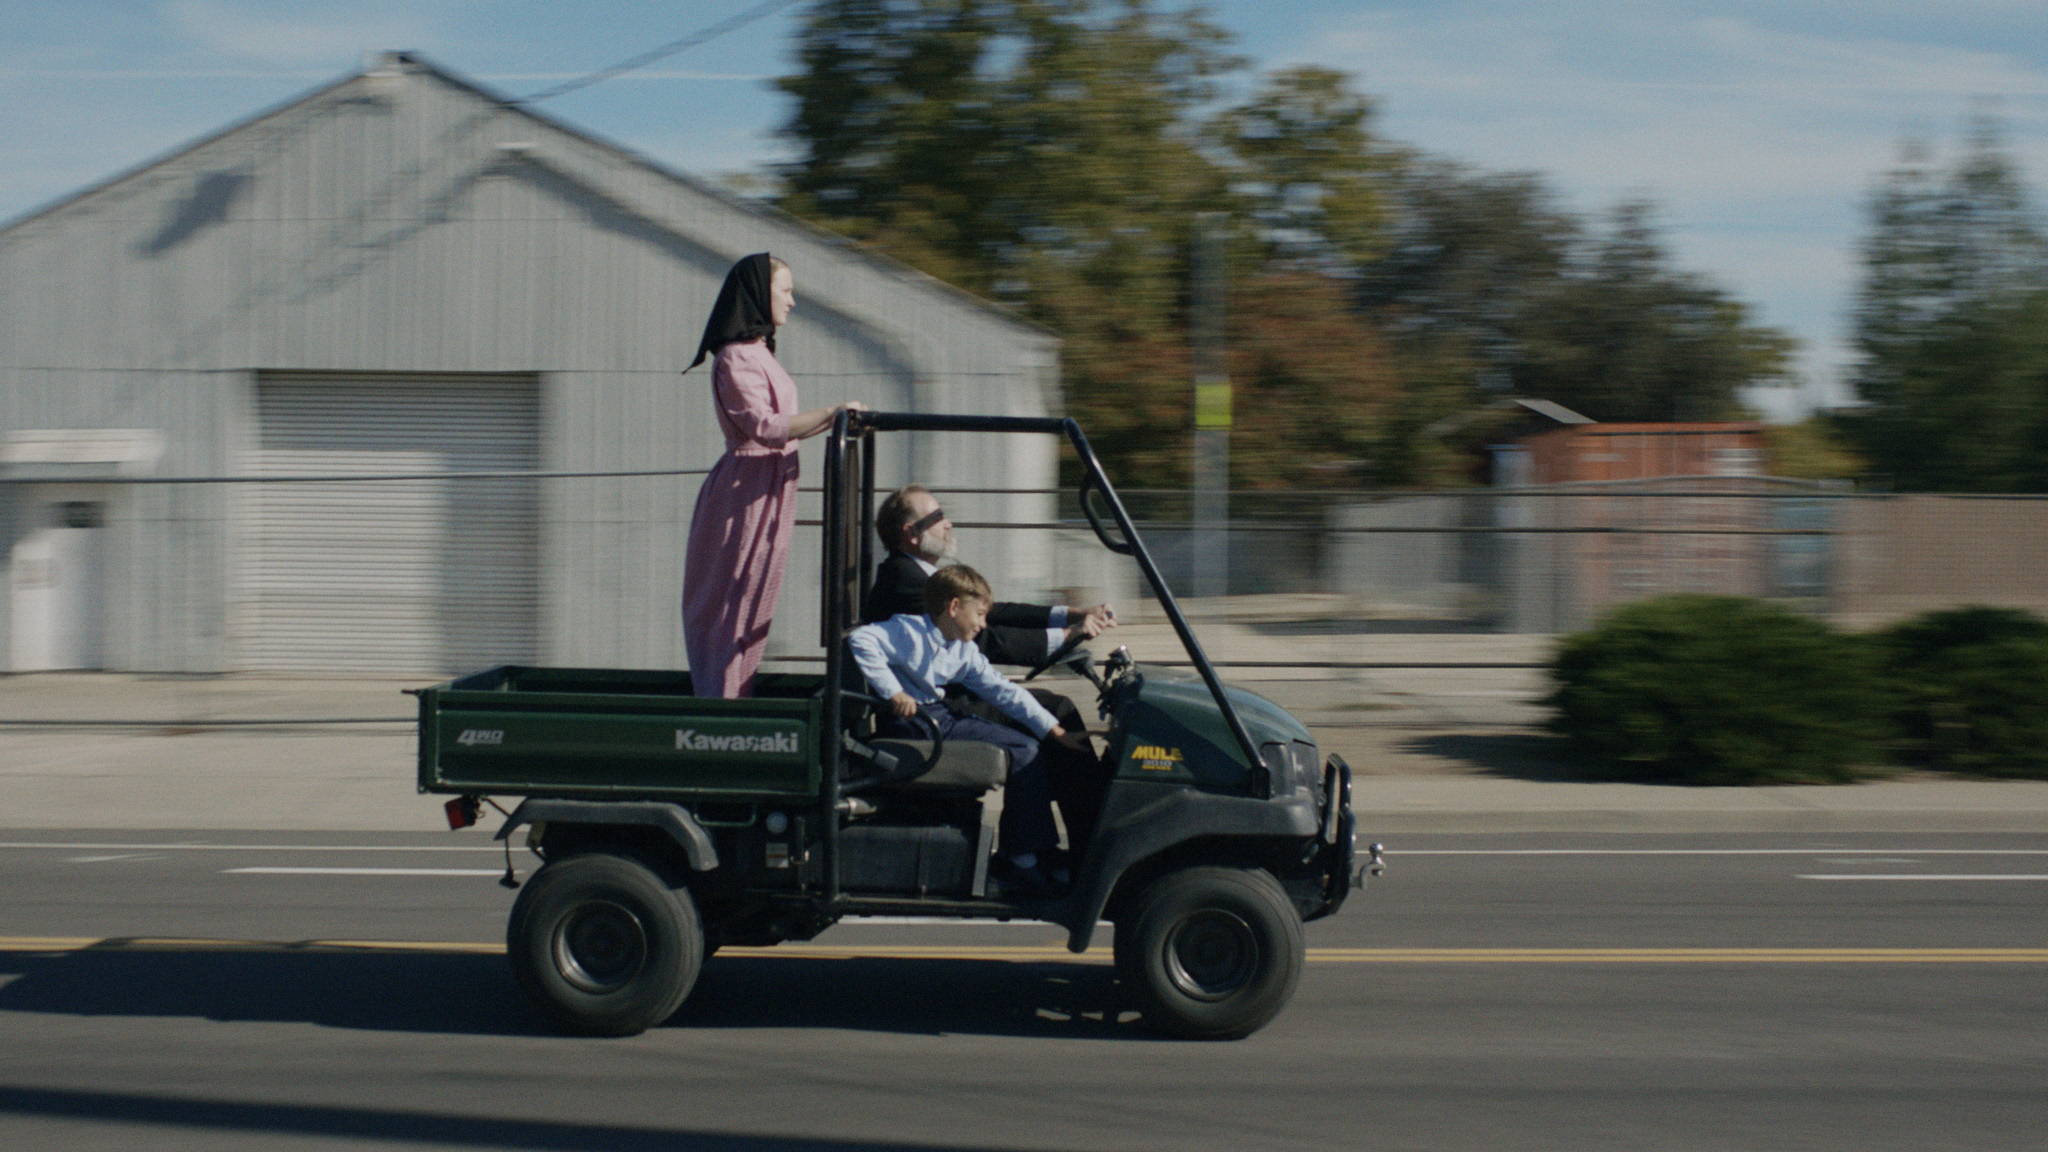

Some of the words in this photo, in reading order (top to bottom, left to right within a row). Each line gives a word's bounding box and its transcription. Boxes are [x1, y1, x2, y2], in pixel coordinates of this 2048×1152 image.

[457, 729, 504, 746] 4WD
[675, 729, 798, 753] Kawasaki
[1131, 746, 1184, 760] MULE
